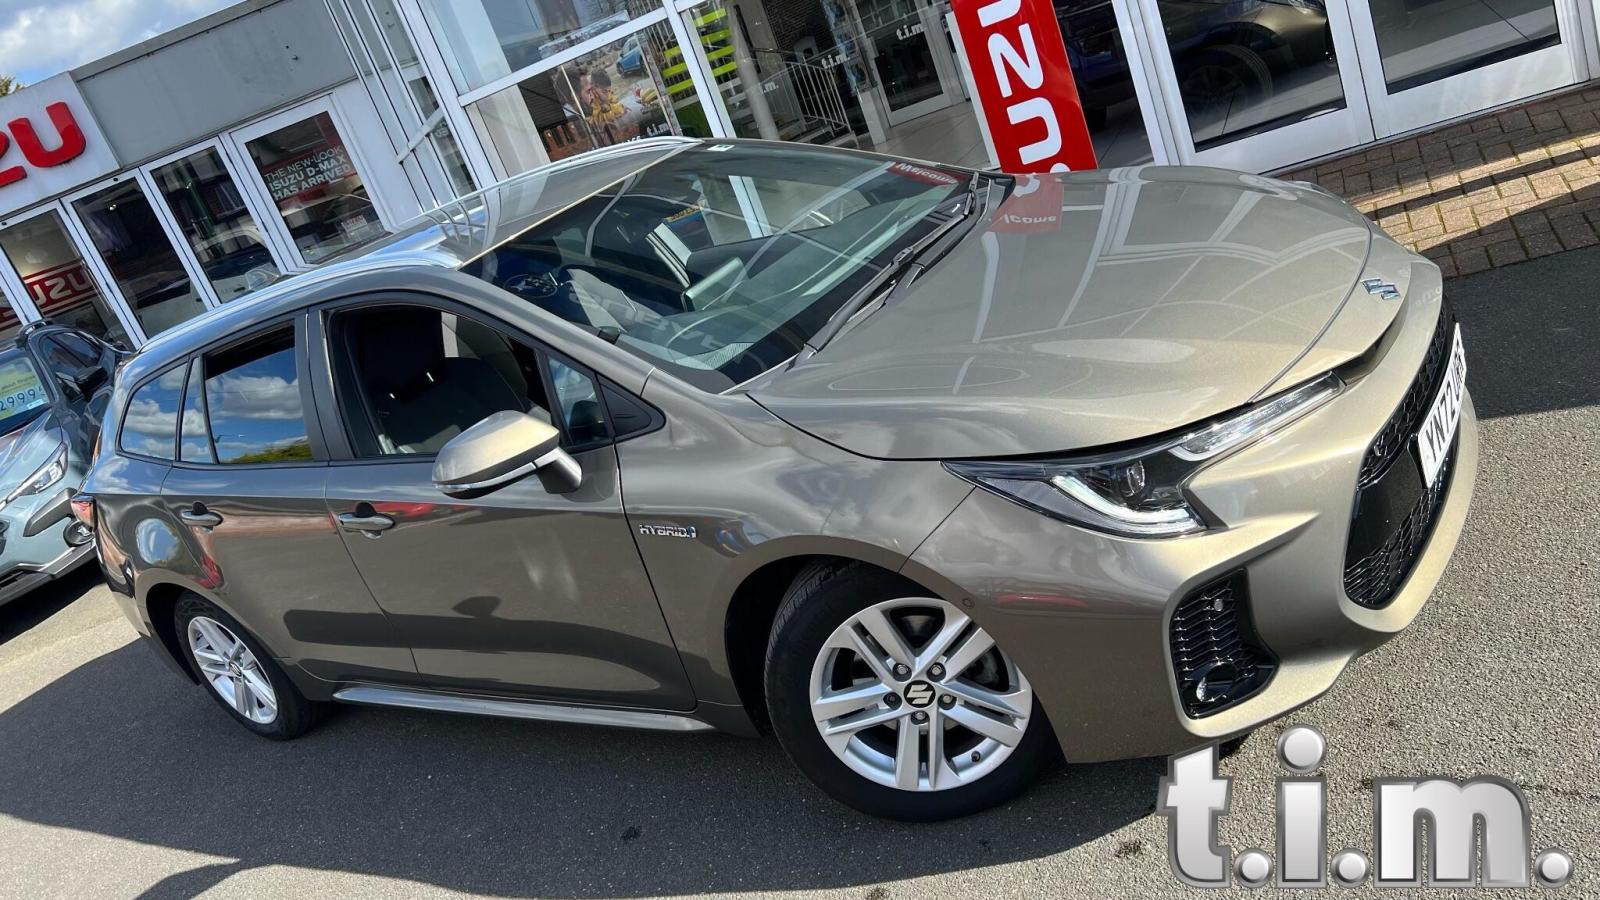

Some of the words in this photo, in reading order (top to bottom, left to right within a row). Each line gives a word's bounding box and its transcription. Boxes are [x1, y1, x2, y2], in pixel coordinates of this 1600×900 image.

[265, 168, 286, 182] THE
[287, 146, 344, 173] NEW-LOOK
[269, 171, 305, 192] ISUZU
[306, 153, 346, 177] D-MAX
[273, 185, 299, 201] HAS
[301, 163, 352, 191] ARRIVED
[1426, 380, 1456, 463] YN72
